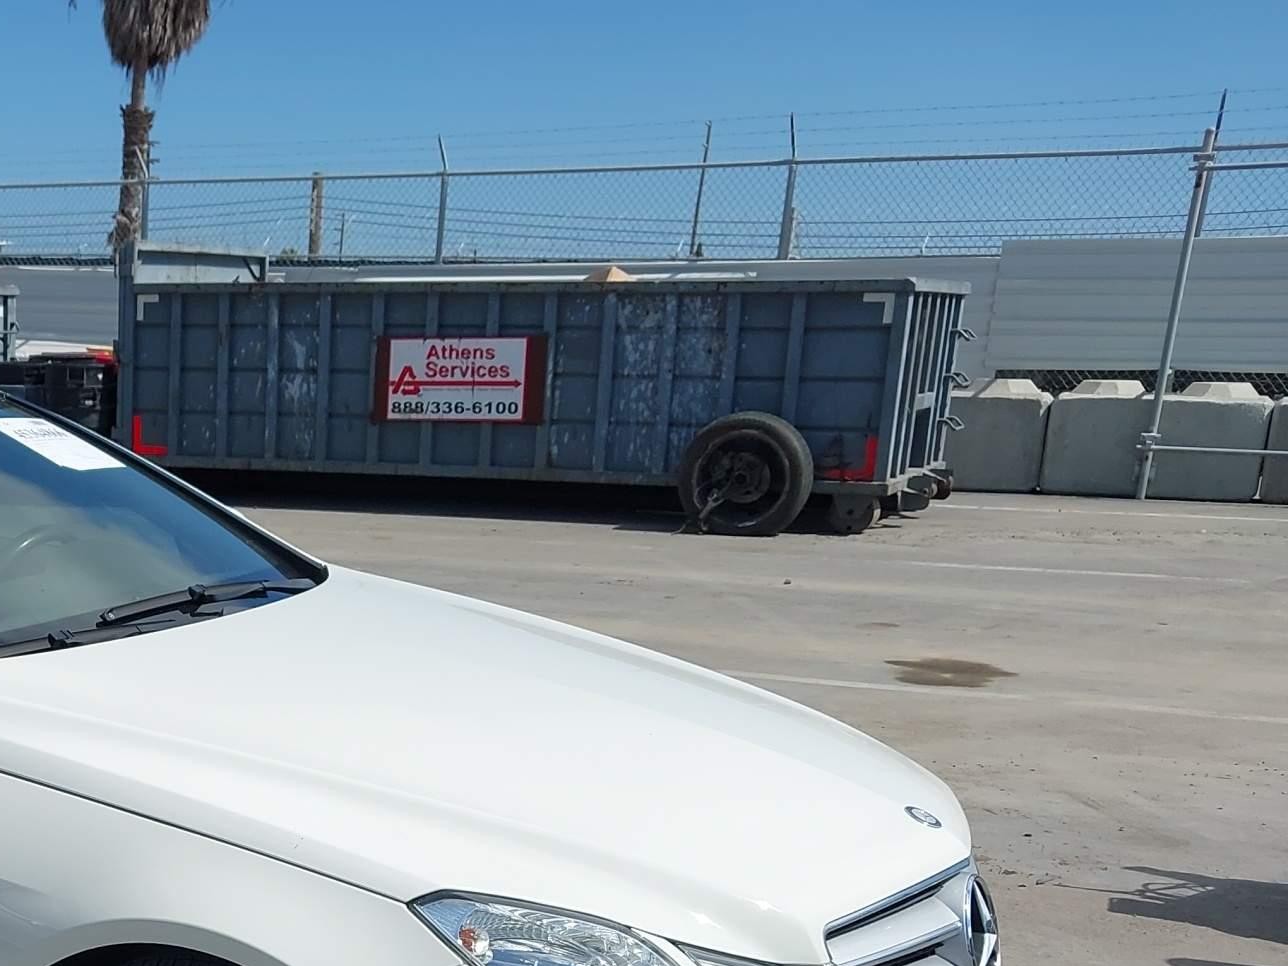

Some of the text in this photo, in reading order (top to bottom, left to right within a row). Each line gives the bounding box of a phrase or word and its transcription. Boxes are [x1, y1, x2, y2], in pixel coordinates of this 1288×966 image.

[426, 345, 496, 360] Athens
[424, 361, 511, 379] Services
[390, 401, 520, 415] 888/336-6100
